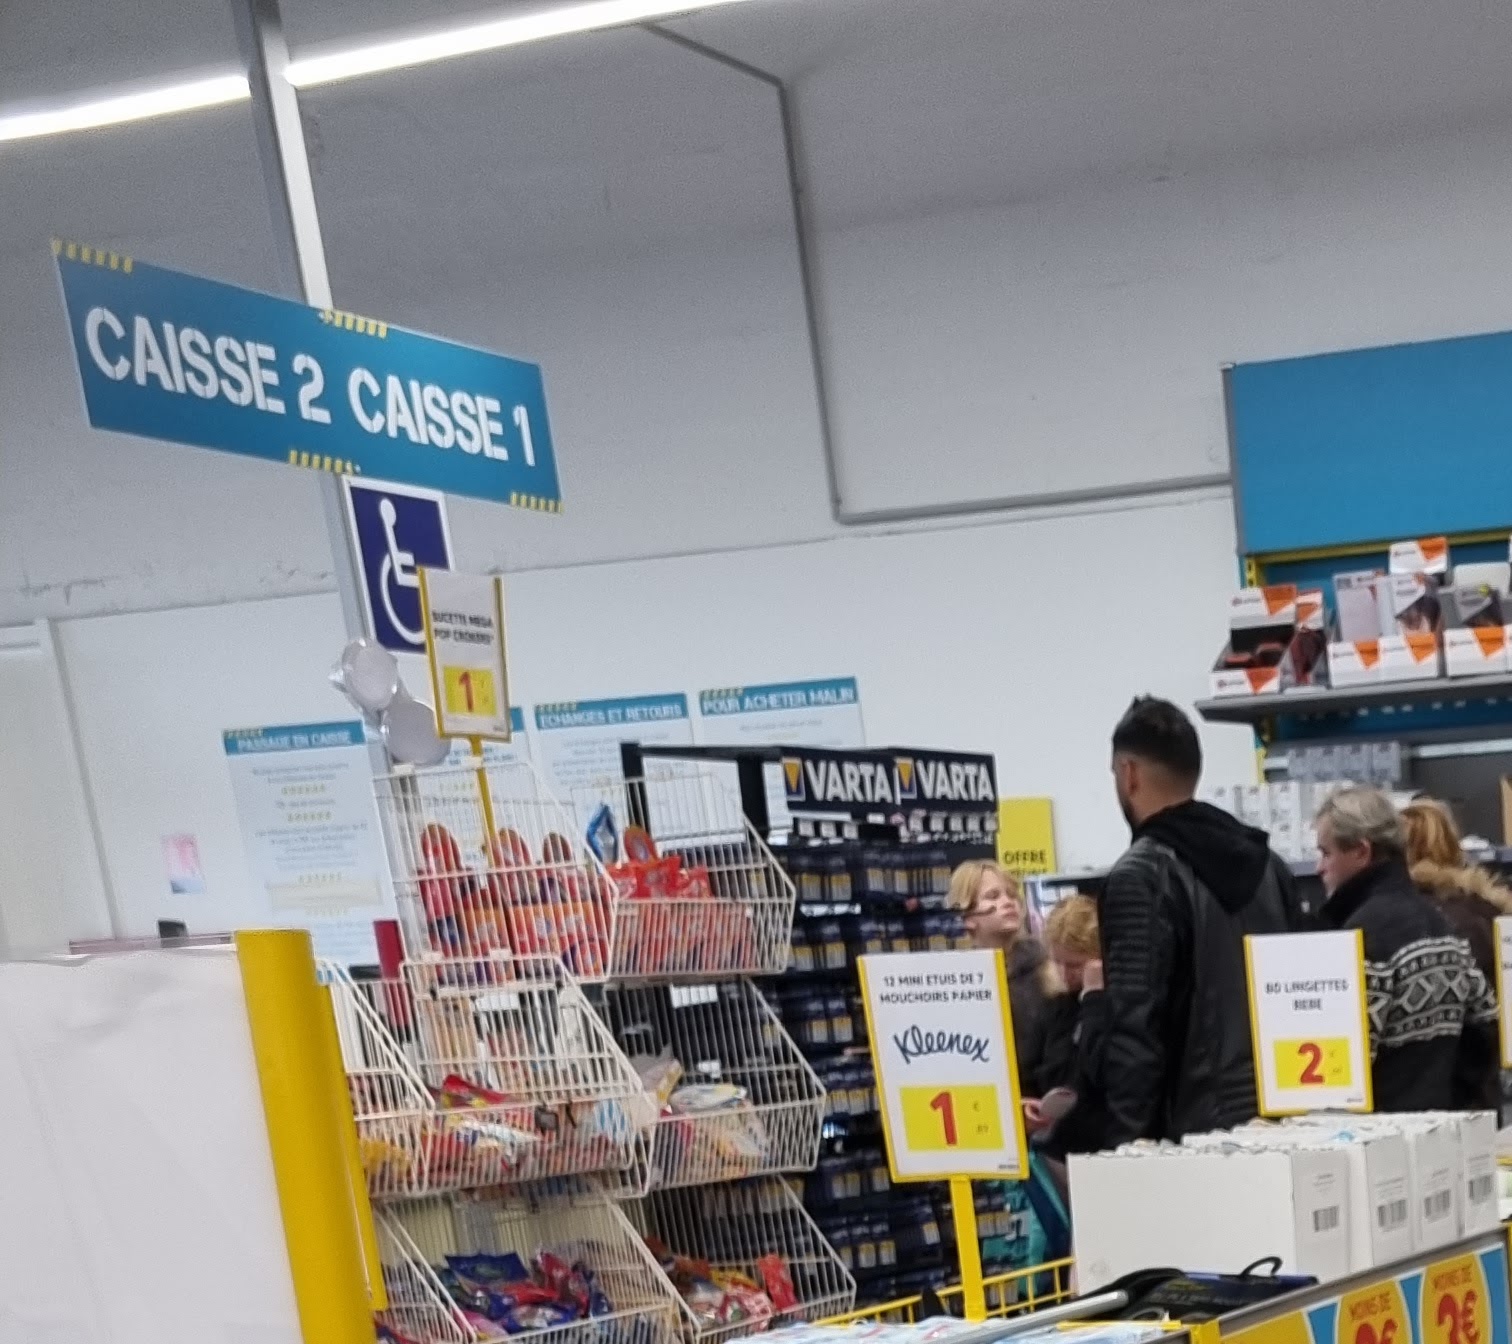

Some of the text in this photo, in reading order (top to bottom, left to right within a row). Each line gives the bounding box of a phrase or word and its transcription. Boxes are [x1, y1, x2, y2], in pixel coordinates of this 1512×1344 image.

[85, 306, 536, 468] CAISSE 2 CAISSE 1
[459, 671, 475, 713] 1
[805, 759, 889, 803] VARTA
[914, 762, 993, 800] VARTA
[1003, 850, 1047, 865] OFFRE
[880, 989, 992, 1005] MOUCHOIRS PAPIER
[961, 972, 974, 985] DE
[893, 1024, 990, 1065] Kleenex
[1297, 1042, 1325, 1085] 2
[929, 1090, 958, 1147] 1
